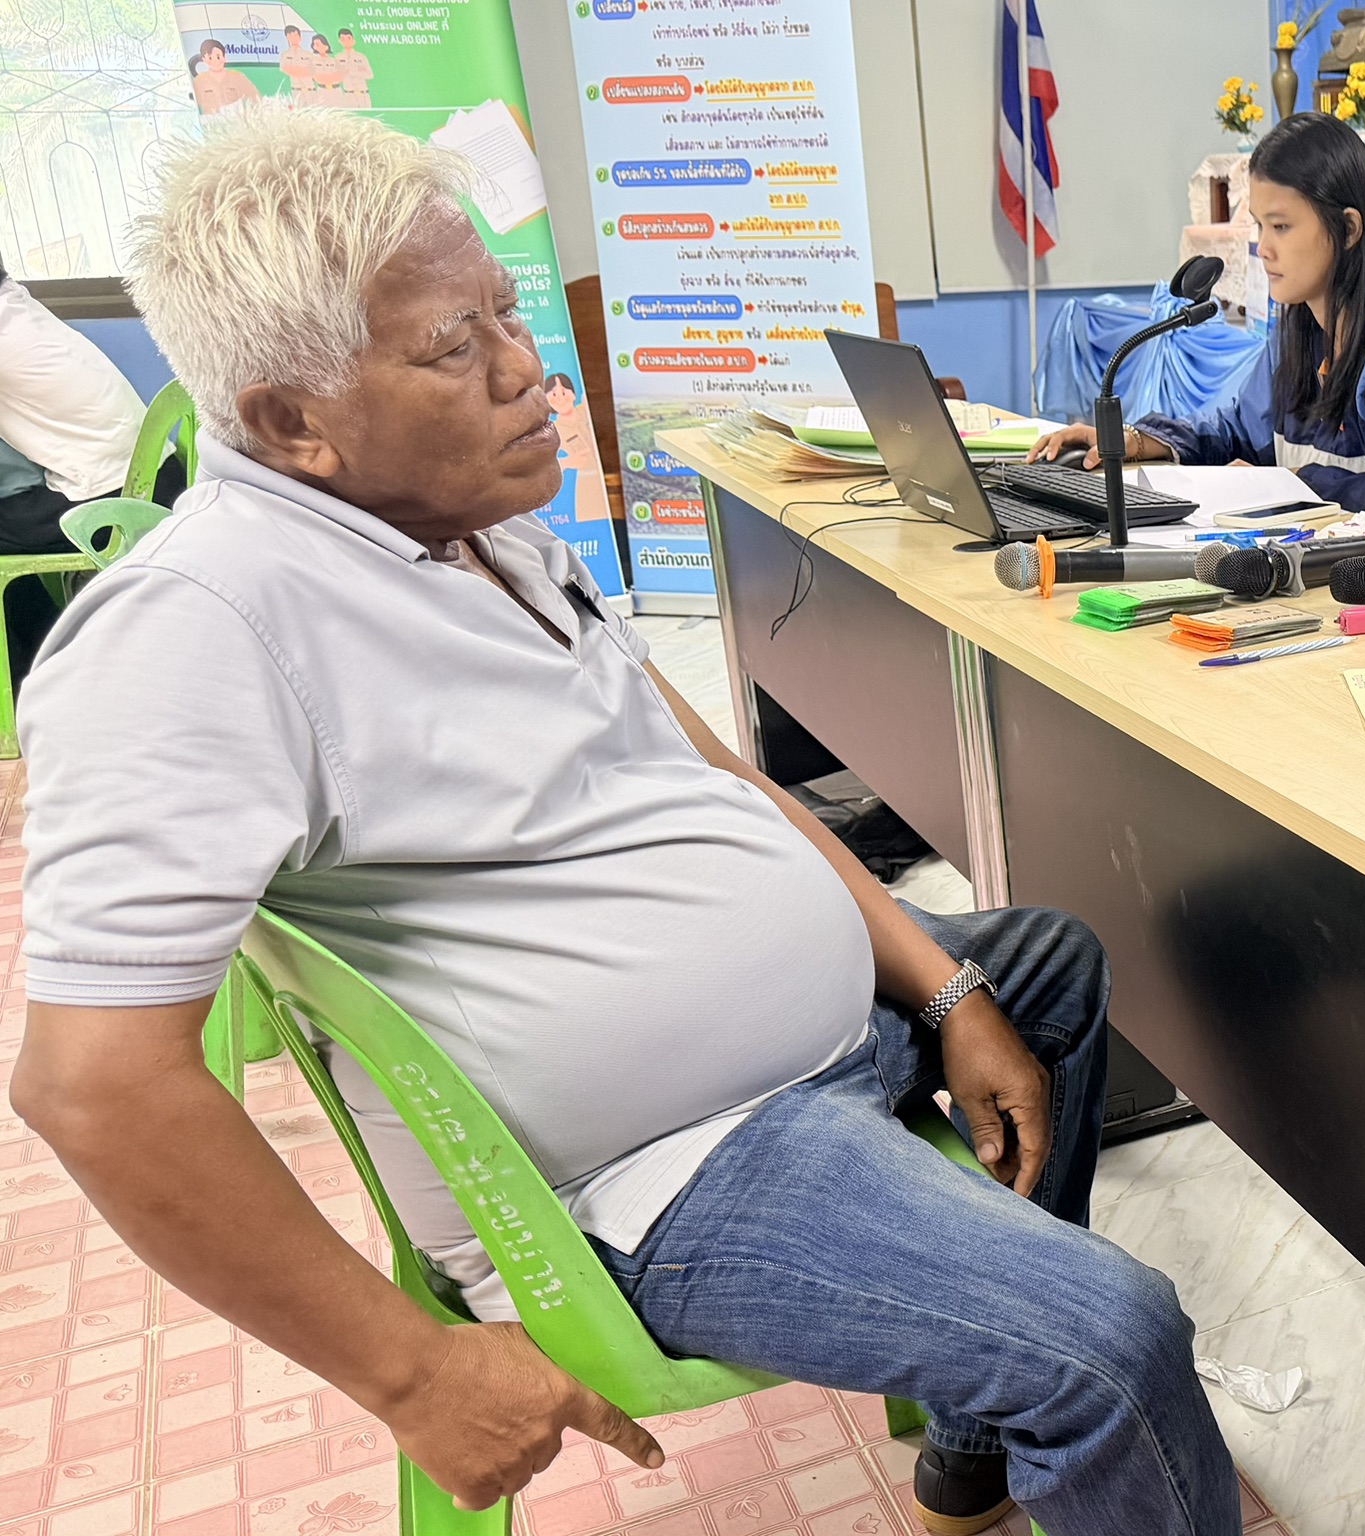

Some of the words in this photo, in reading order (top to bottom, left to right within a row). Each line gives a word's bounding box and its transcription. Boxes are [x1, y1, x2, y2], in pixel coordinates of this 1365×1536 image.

[387, 6, 423, 17] (MOBILE
[425, 7, 450, 18] UNIT)
[406, 21, 438, 31] ONLINE
[517, 276, 551, 291] างไร?
[639, 549, 712, 566] สำนักงานก
